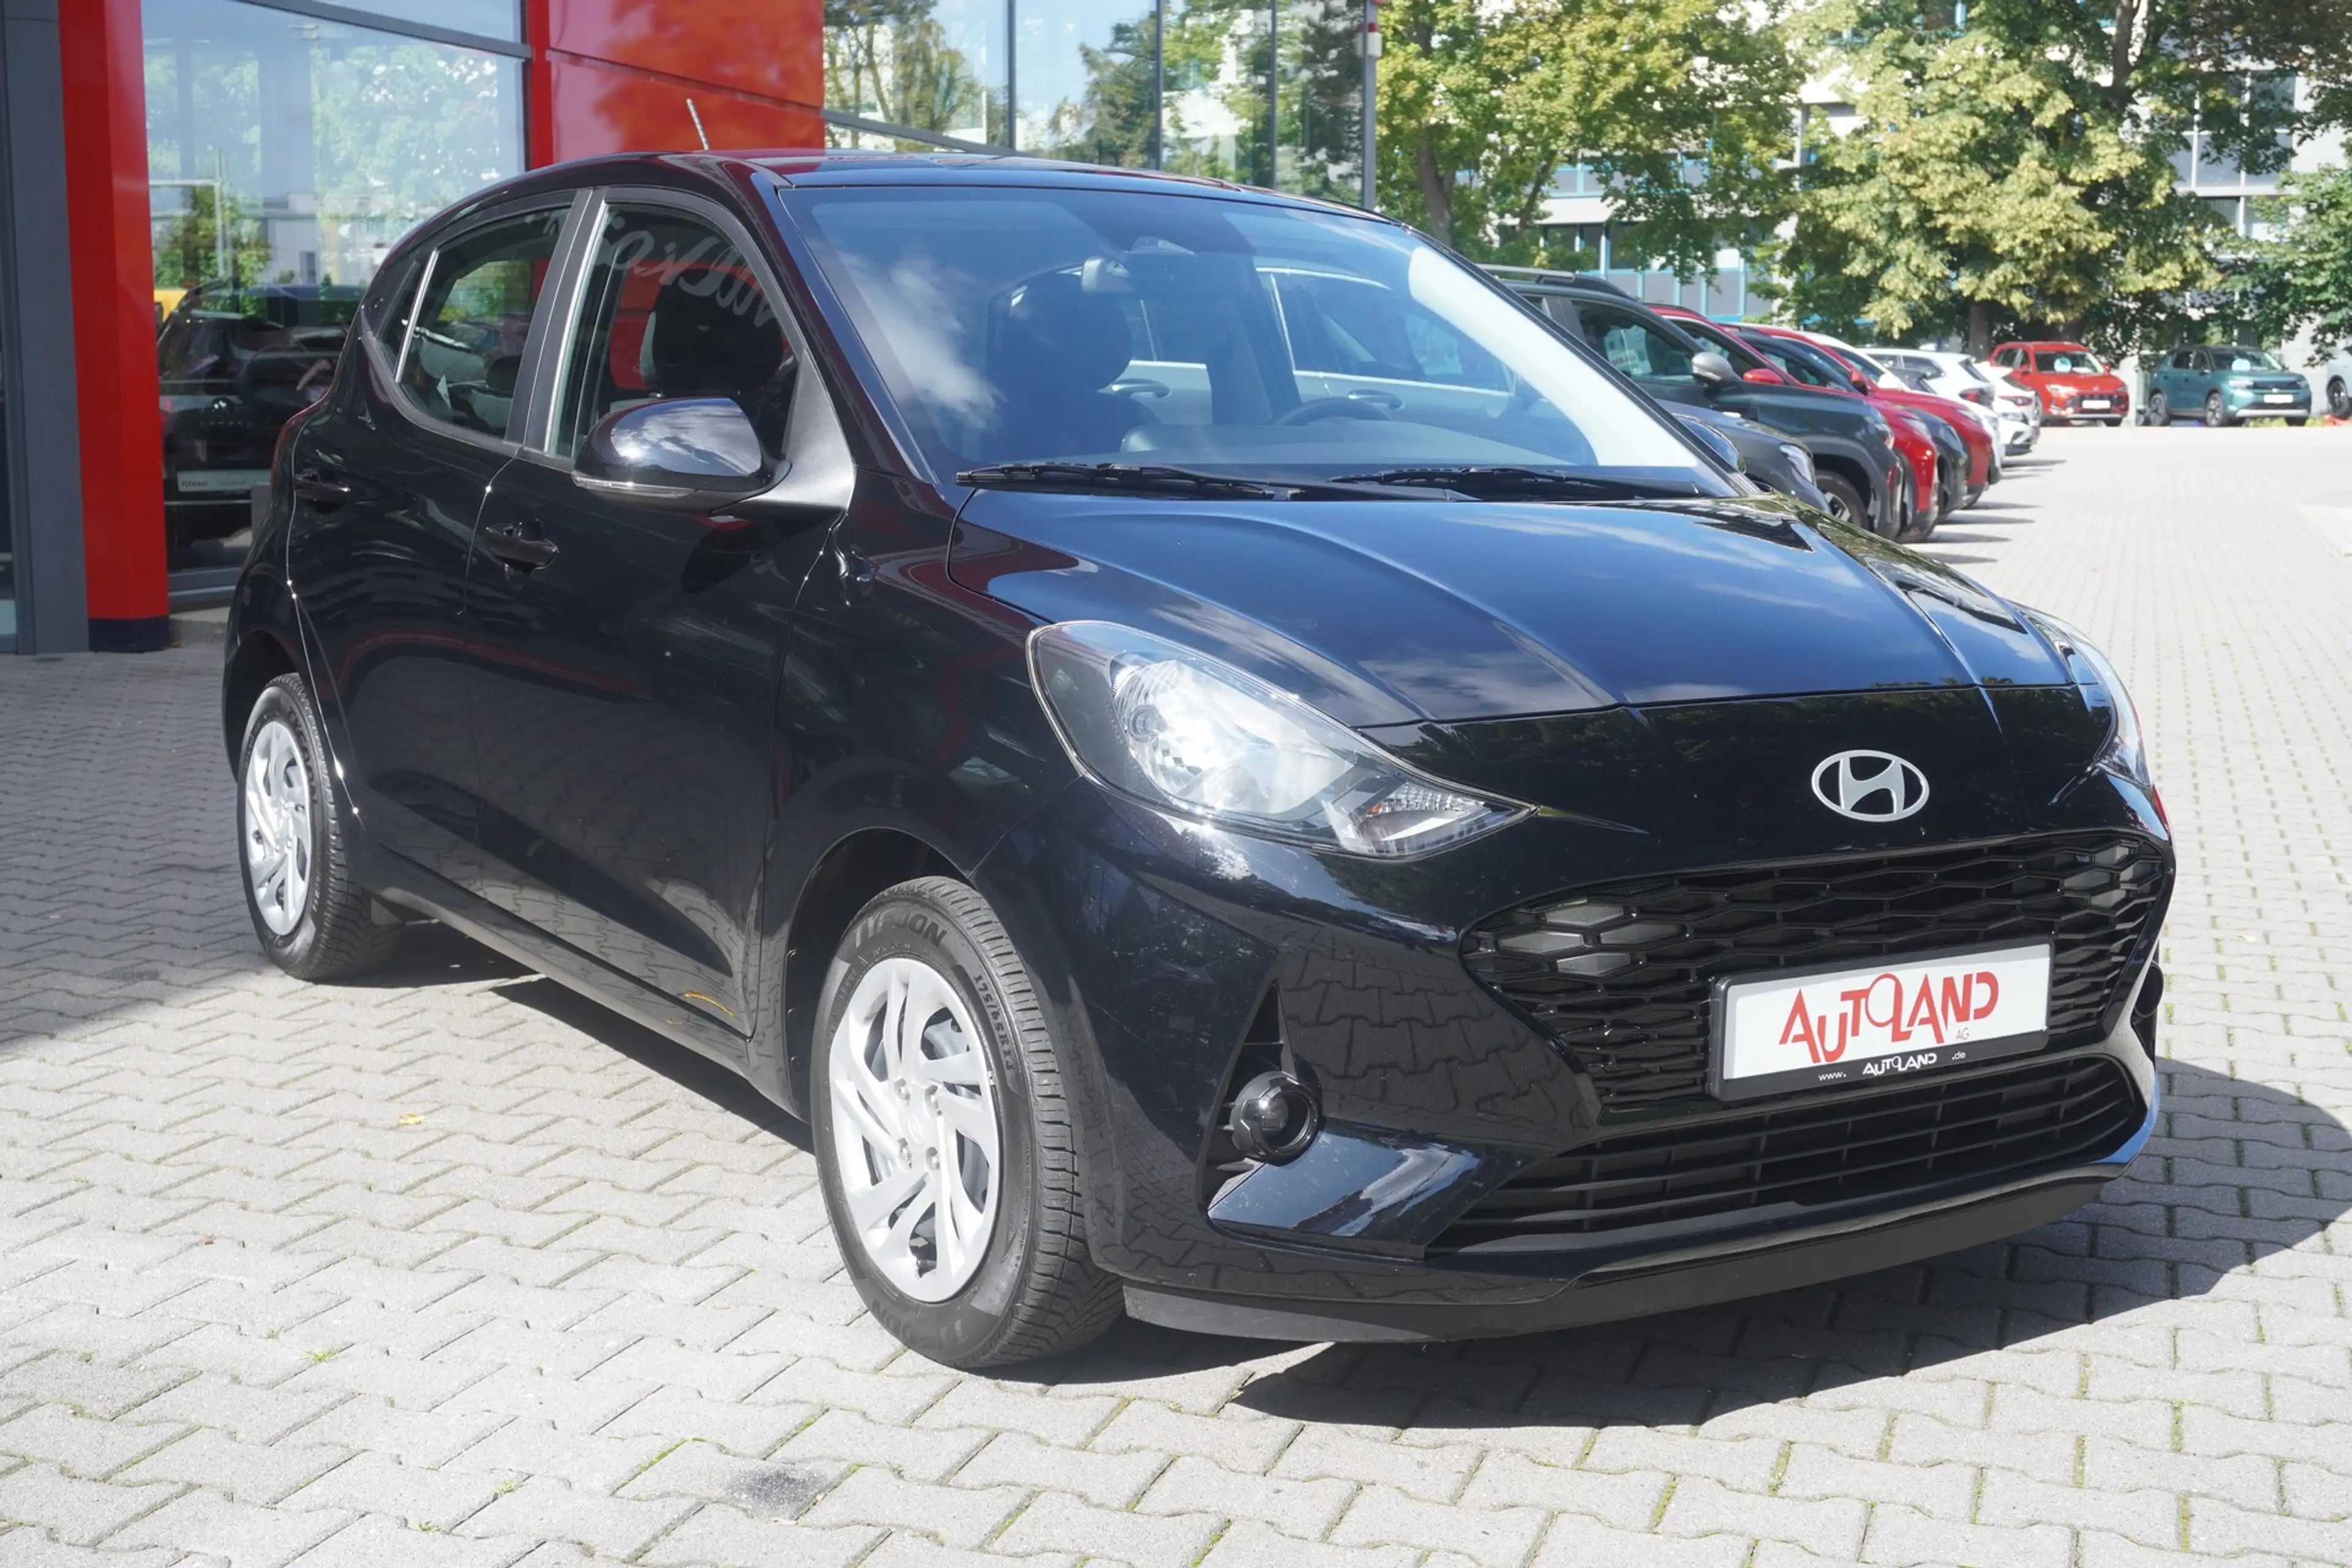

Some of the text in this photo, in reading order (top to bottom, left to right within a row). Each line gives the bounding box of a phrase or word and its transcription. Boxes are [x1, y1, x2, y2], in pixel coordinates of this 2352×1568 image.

[1779, 972, 1999, 1064] AUTOLAND
[1956, 1027, 1970, 1041] AG
[1818, 1071, 1847, 1082] www.
[1951, 1050, 1967, 1061] .de
